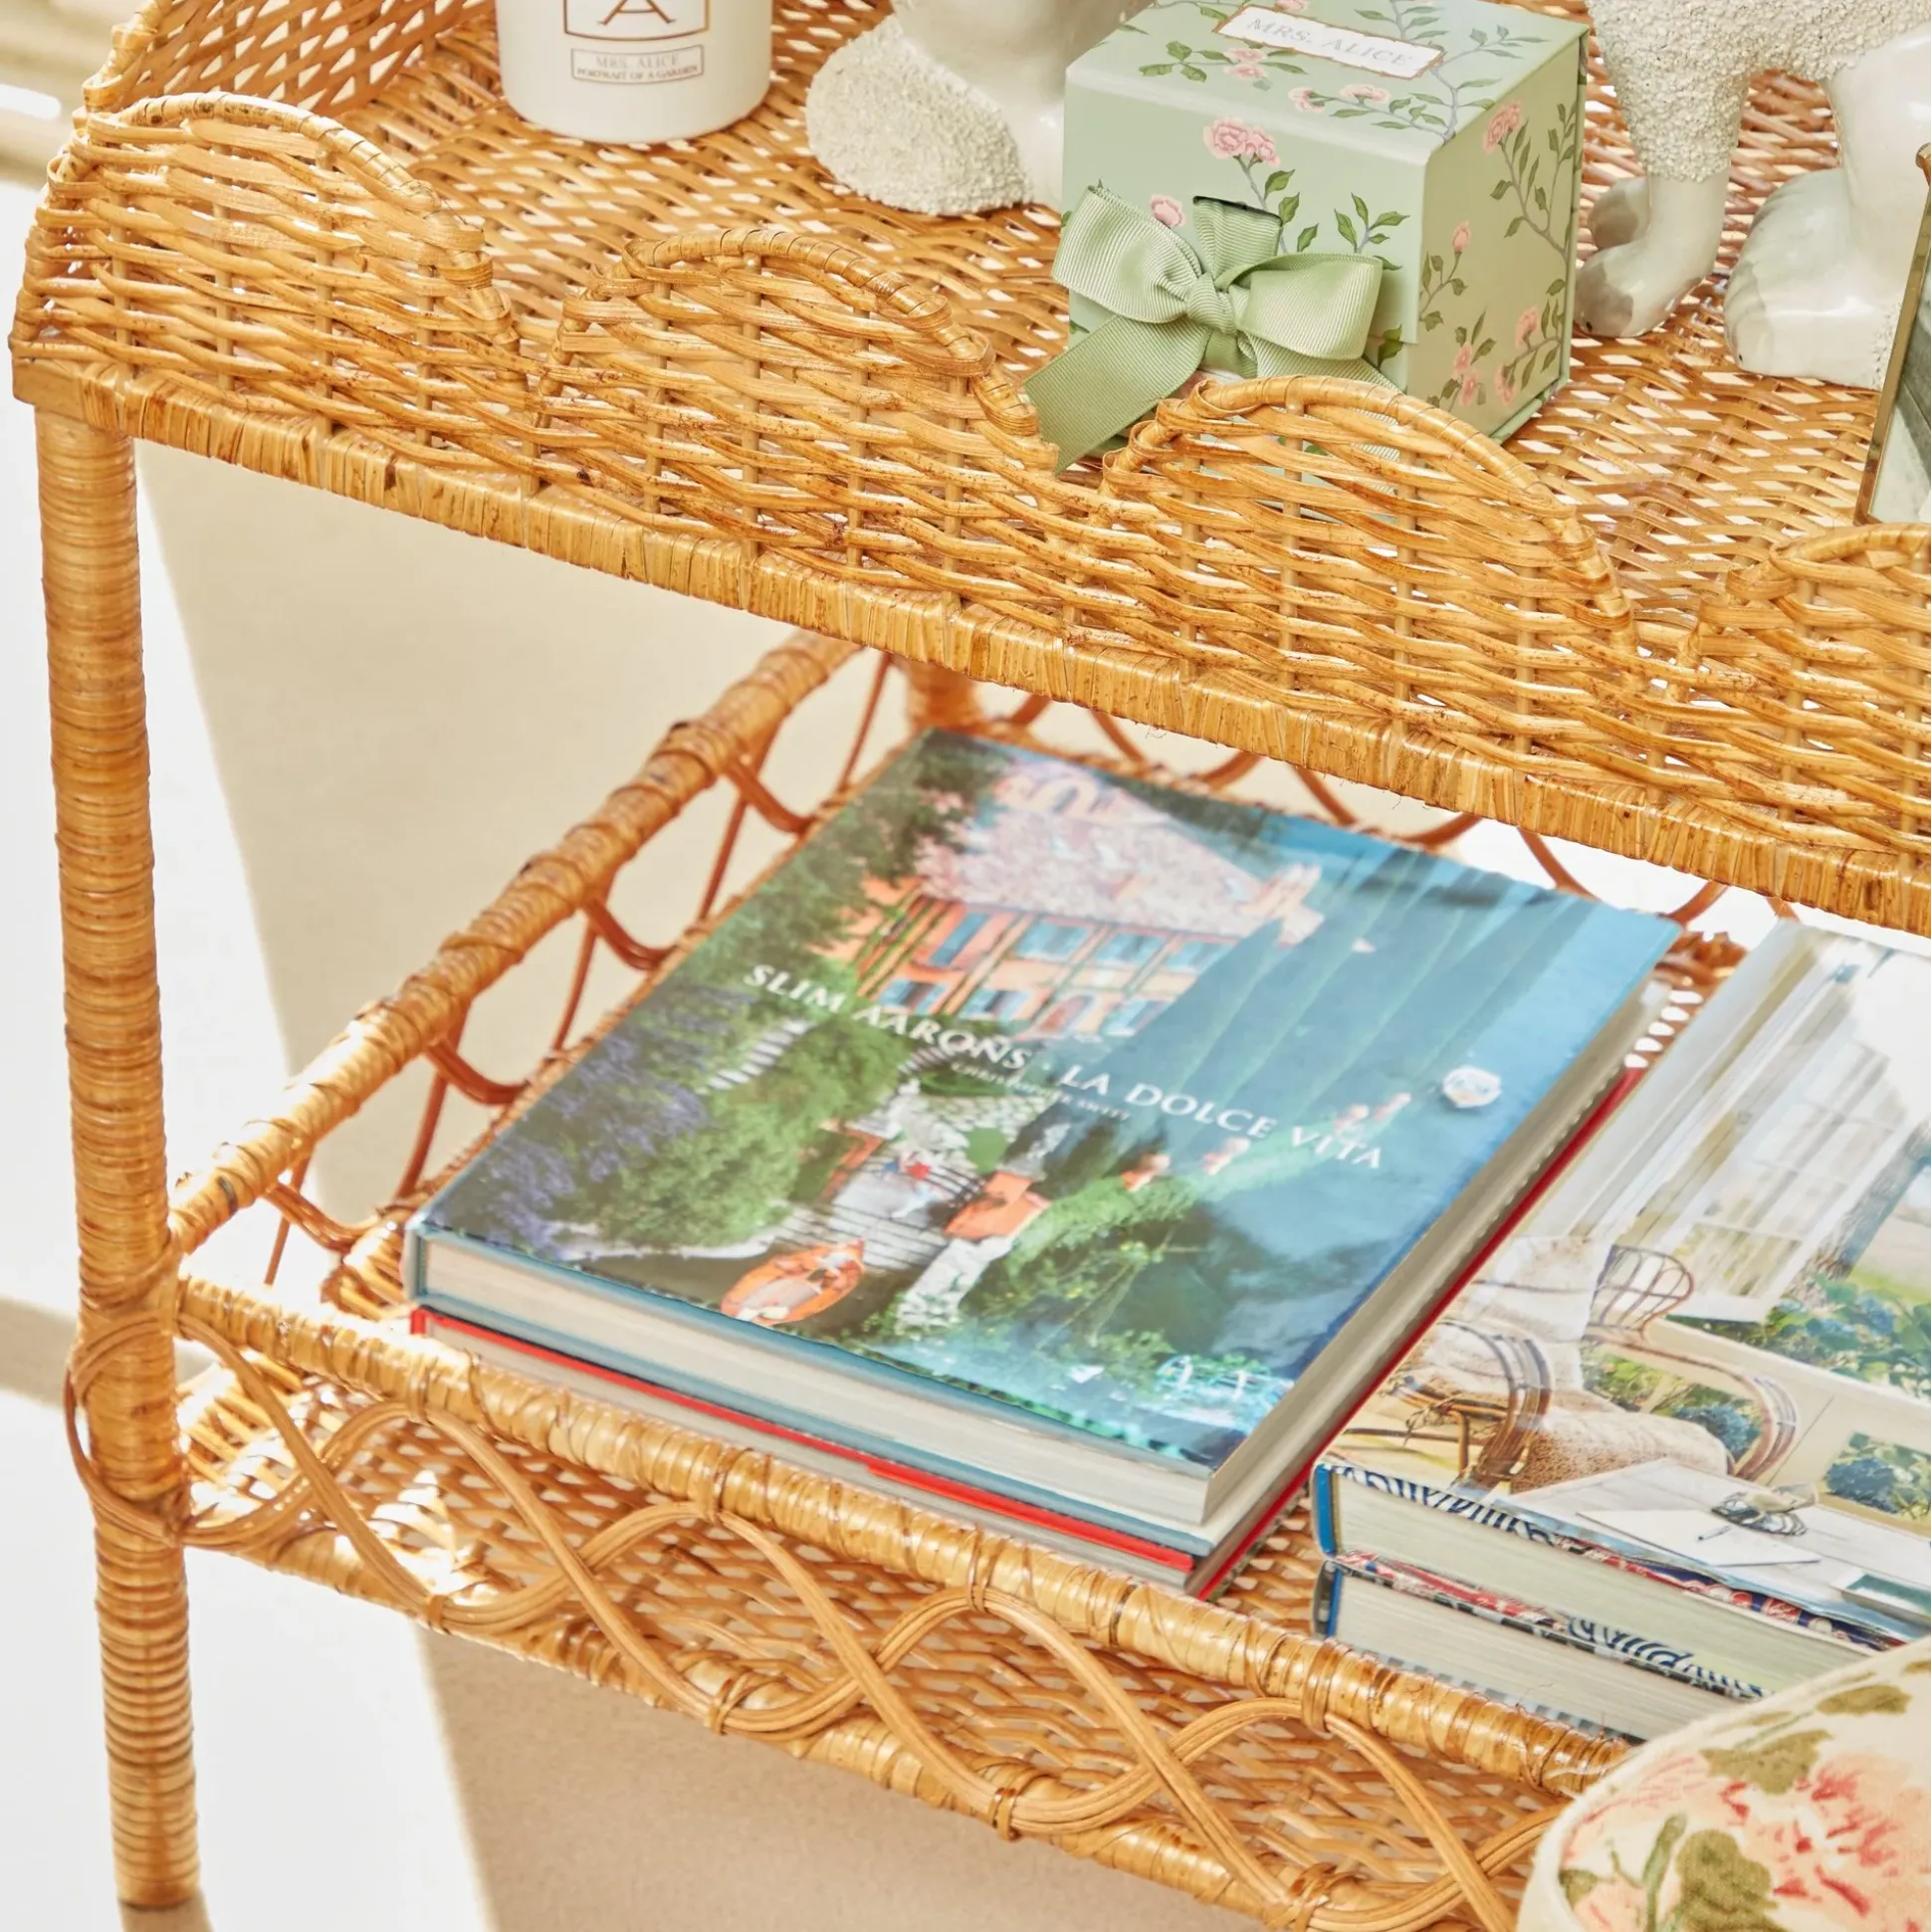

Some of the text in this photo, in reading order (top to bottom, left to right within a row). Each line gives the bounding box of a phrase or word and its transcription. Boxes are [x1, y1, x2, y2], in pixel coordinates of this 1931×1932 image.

[636, 53, 680, 69] ALICE
[1247, 18, 1412, 67] MRS. ALICE
[745, 965, 846, 1013] SLIM
[853, 1004, 1032, 1069] AARONS
[1058, 1064, 1111, 1096] LA
[1125, 1083, 1278, 1140] DOLCE
[1292, 1126, 1383, 1170] VITA
